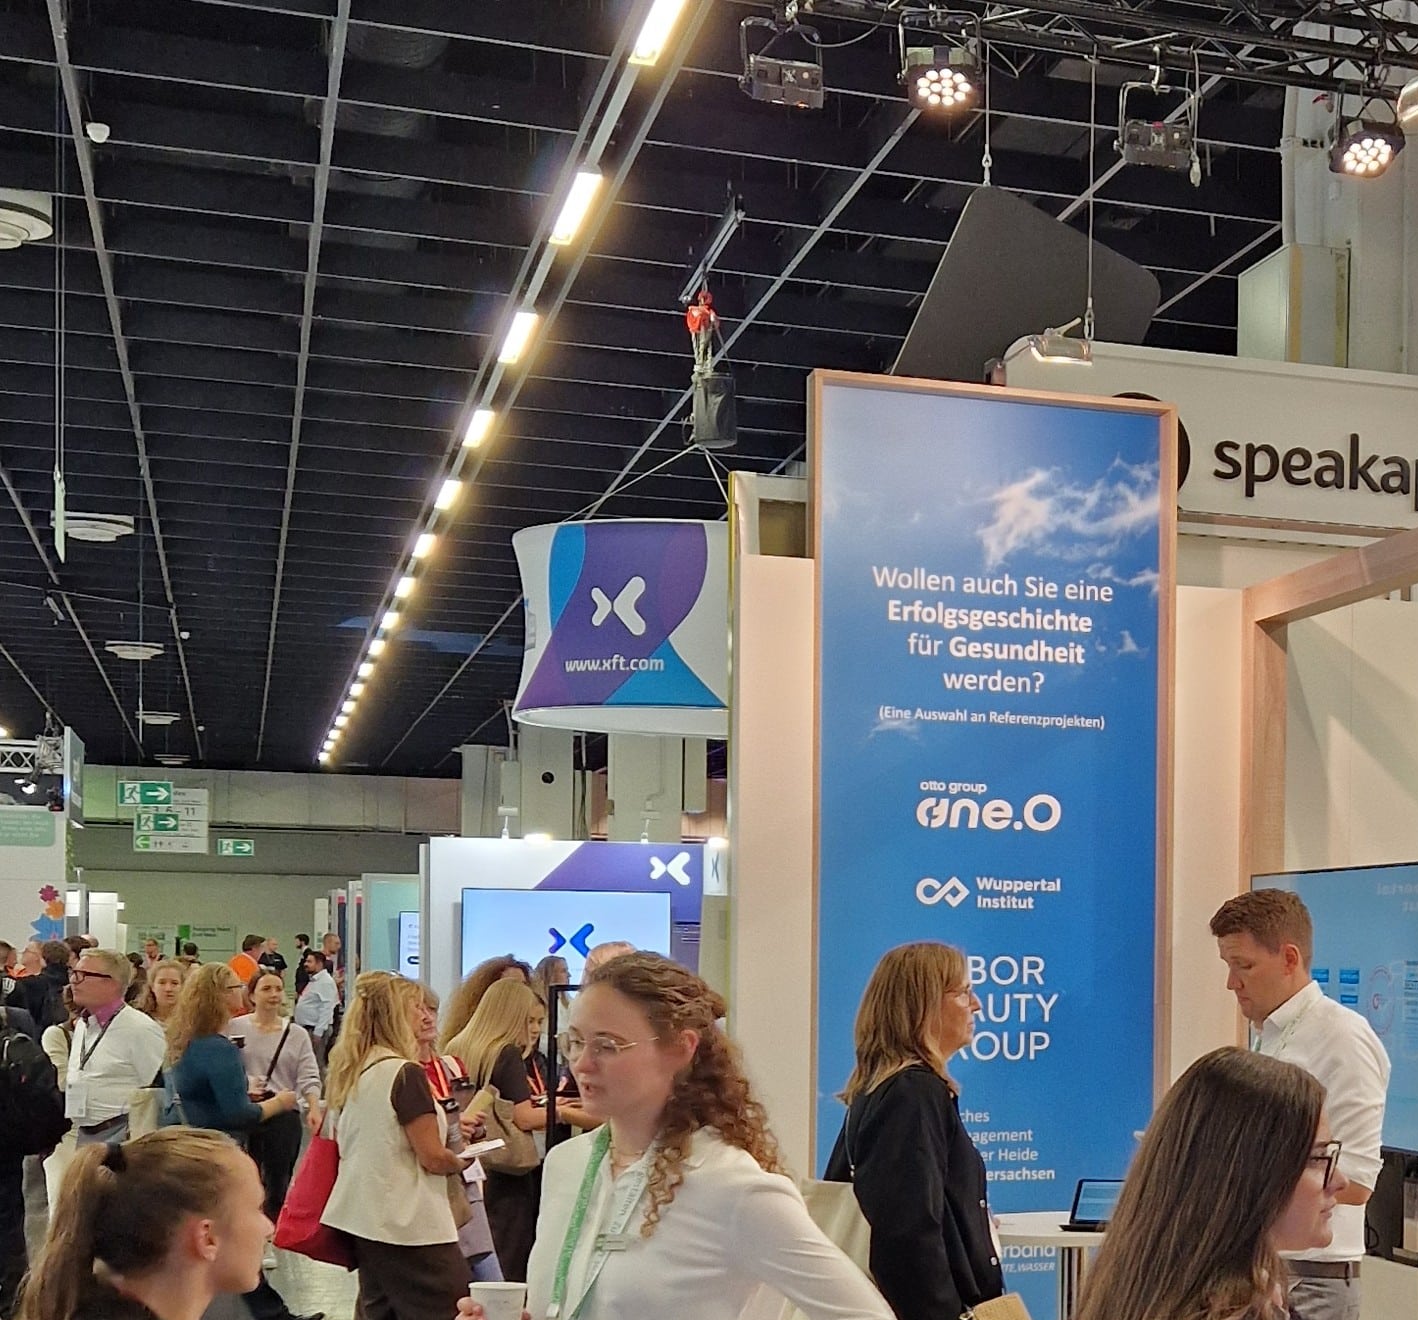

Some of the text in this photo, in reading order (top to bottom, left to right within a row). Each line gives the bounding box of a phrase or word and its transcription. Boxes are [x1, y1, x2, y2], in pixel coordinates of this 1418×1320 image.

[872, 564, 1113, 602] Wollen auch Sie eine
[887, 600, 1093, 635] Erfolgsgeschichte
[907, 634, 1085, 665] für Gesundheit
[565, 654, 665, 673] www.xft.com
[943, 668, 1045, 694] werden?
[878, 704, 1105, 731] (Eine Auswahl an Referenzprojekten)
[920, 780, 988, 796] otto group
[976, 876, 1061, 895] Wuppertal
[976, 892, 1035, 910] Institut
[998, 1148, 1039, 1161] Heide
